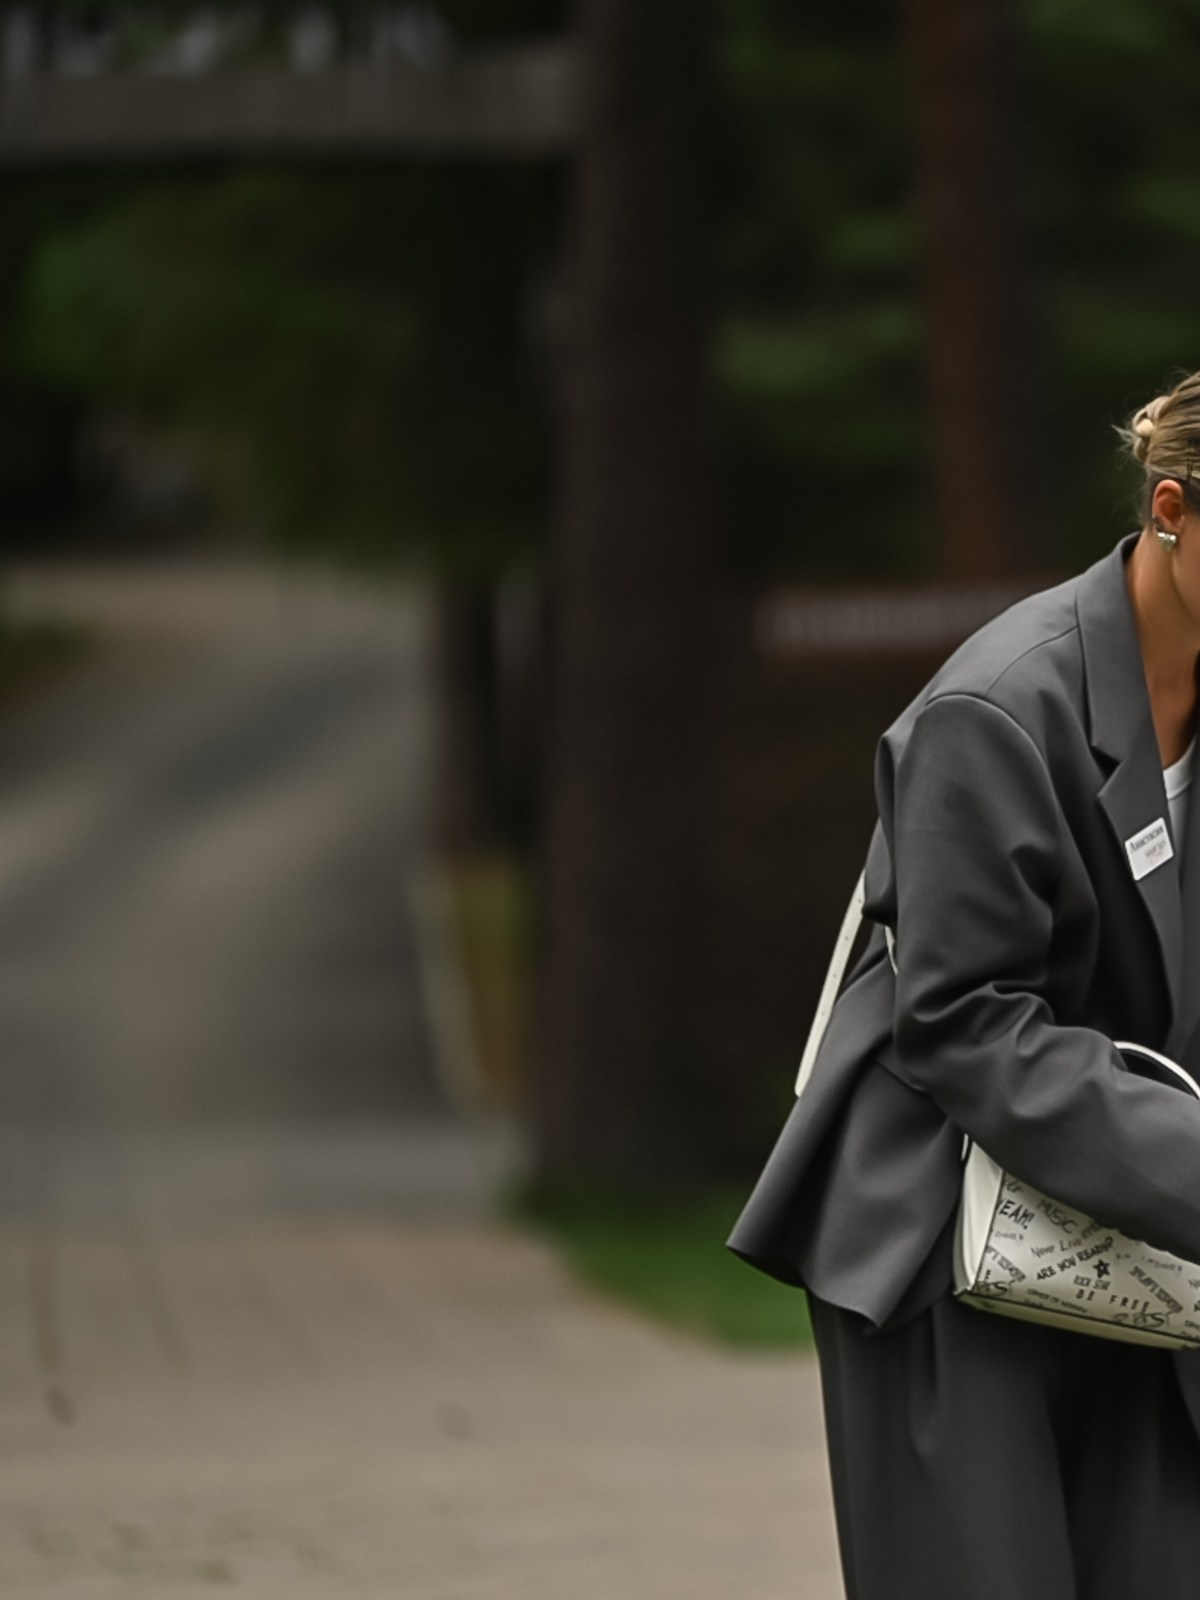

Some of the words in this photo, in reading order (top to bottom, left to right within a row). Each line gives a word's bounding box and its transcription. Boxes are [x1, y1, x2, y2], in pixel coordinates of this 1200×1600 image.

[1036, 1264, 1057, 1282] ARE
[1057, 1252, 1078, 1271] YOU
[1109, 1294, 1151, 1313] FREE
